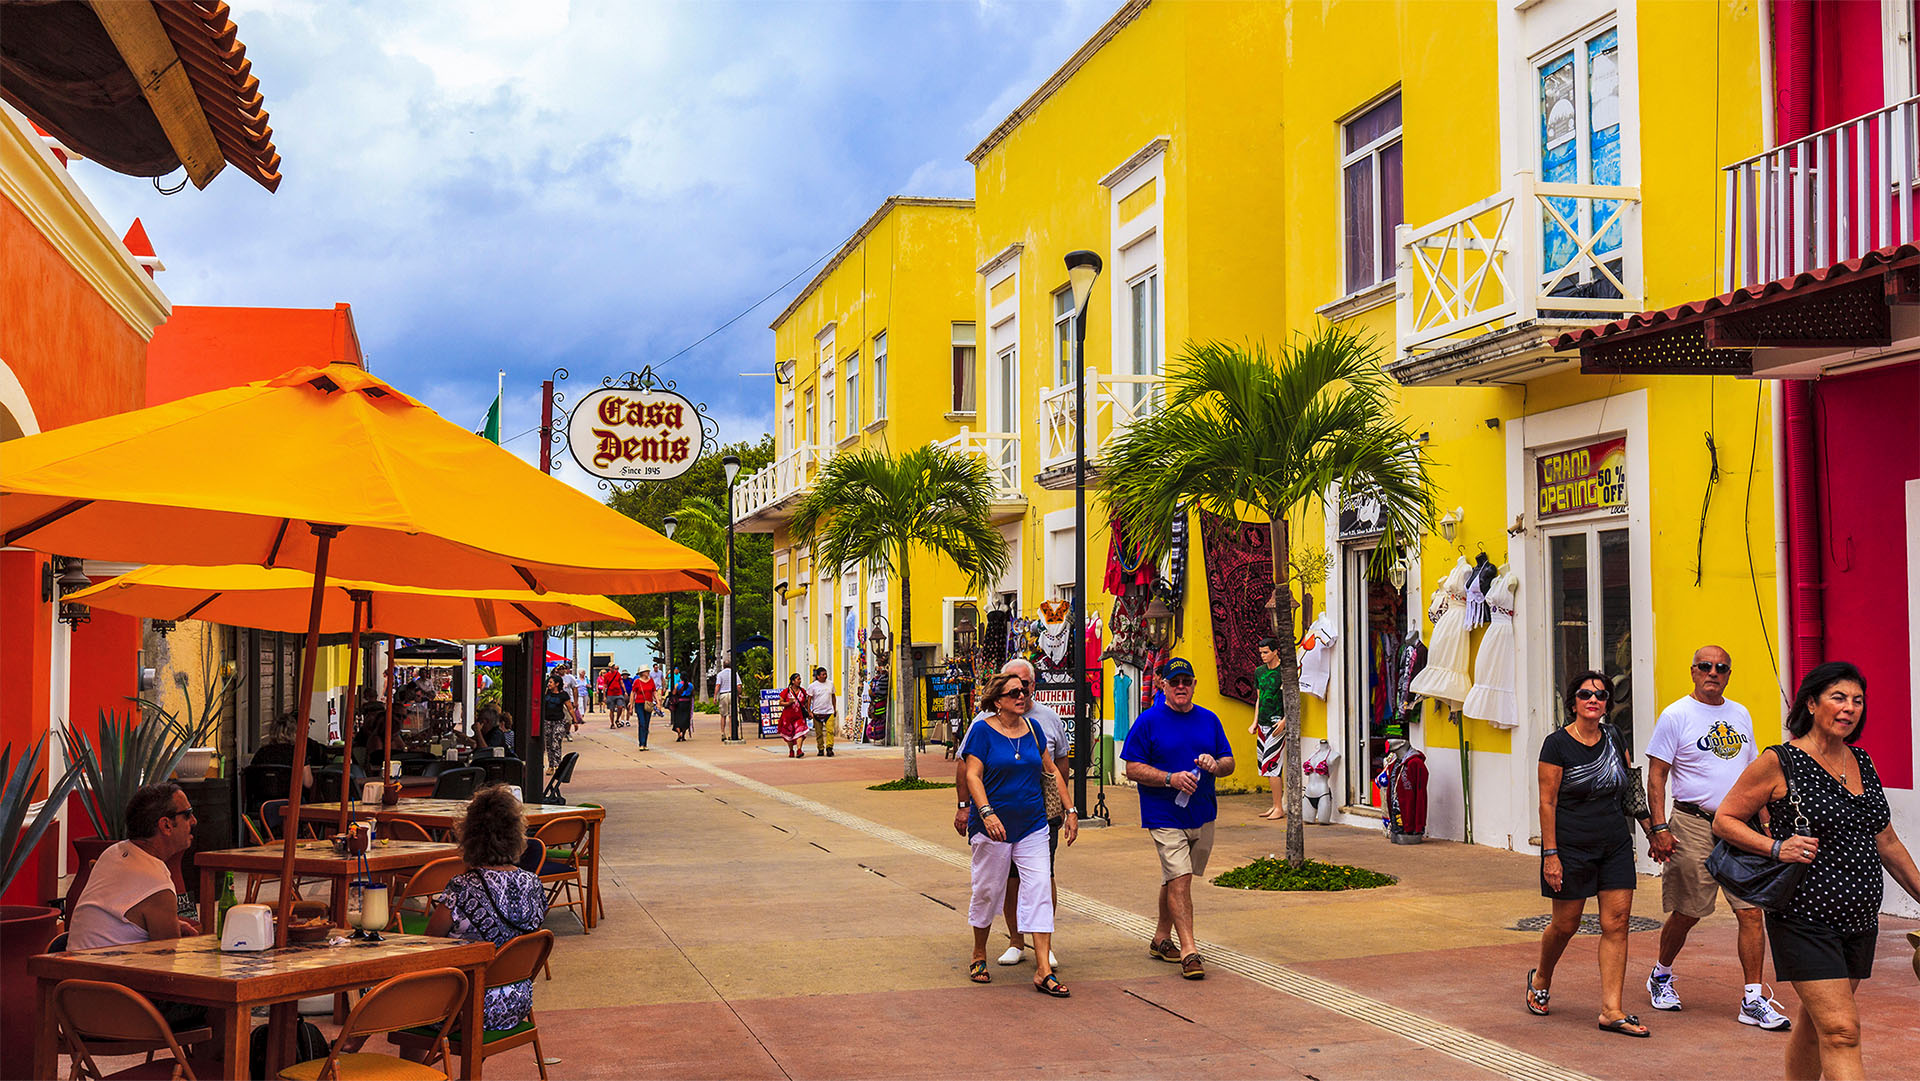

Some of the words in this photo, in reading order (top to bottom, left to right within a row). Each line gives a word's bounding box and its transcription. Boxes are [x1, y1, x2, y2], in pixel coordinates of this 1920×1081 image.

[598, 396, 684, 430] Casa
[592, 428, 690, 469] Denis
[619, 466, 642, 476] Since
[1544, 450, 1590, 483] GRAND
[1597, 468, 1611, 486] 50
[1615, 465, 1625, 483] %
[1540, 478, 1598, 513] OPENING
[1603, 484, 1624, 503] OFF
[1697, 733, 1748, 751] Corona
